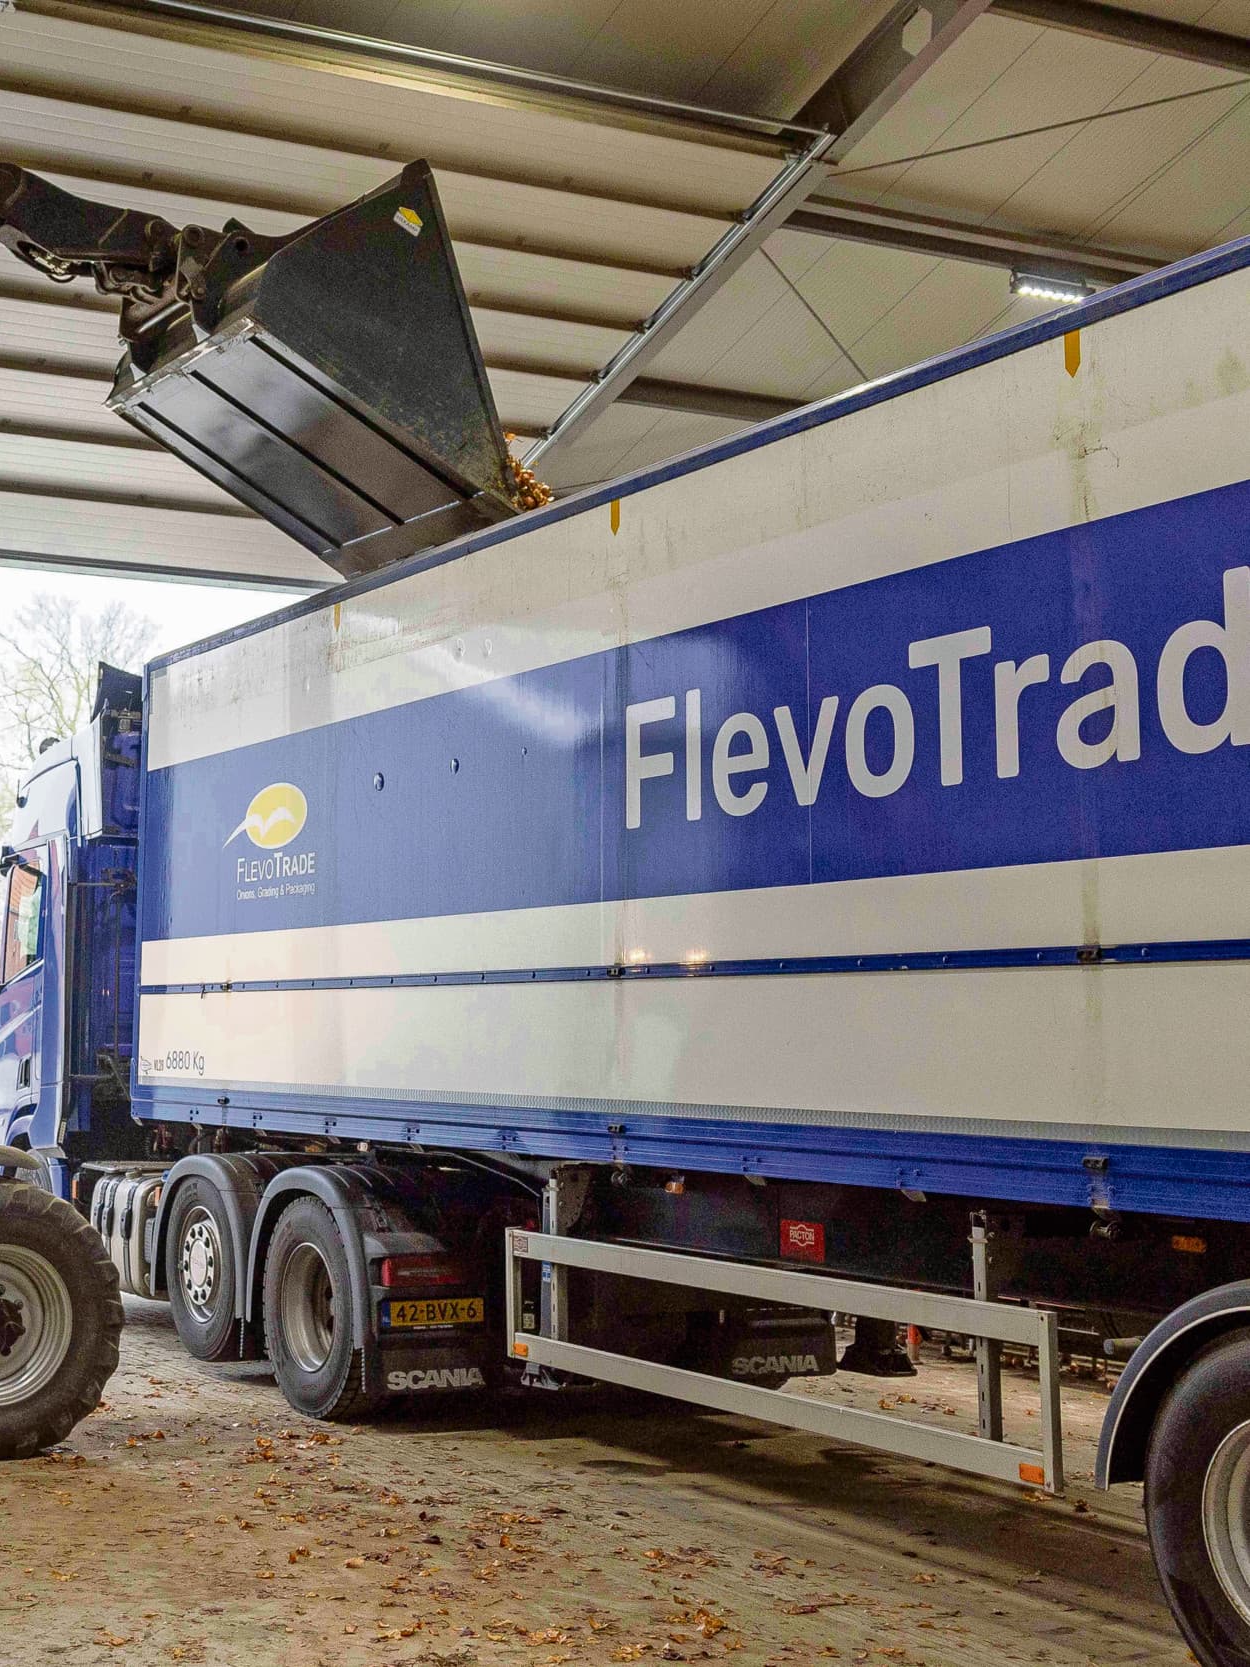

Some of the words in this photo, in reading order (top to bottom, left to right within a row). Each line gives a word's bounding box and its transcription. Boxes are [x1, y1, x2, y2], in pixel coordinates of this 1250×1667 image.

[280, 884, 284, 895] &
[285, 882, 316, 896] Packaging
[166, 1051, 190, 1070] 6880
[192, 1051, 204, 1076] Kg
[790, 1230, 815, 1241] PACTON
[396, 1301, 478, 1322] 42-BVX-6
[731, 1355, 820, 1376] SCANIA
[387, 1367, 486, 1391] SCANIA
